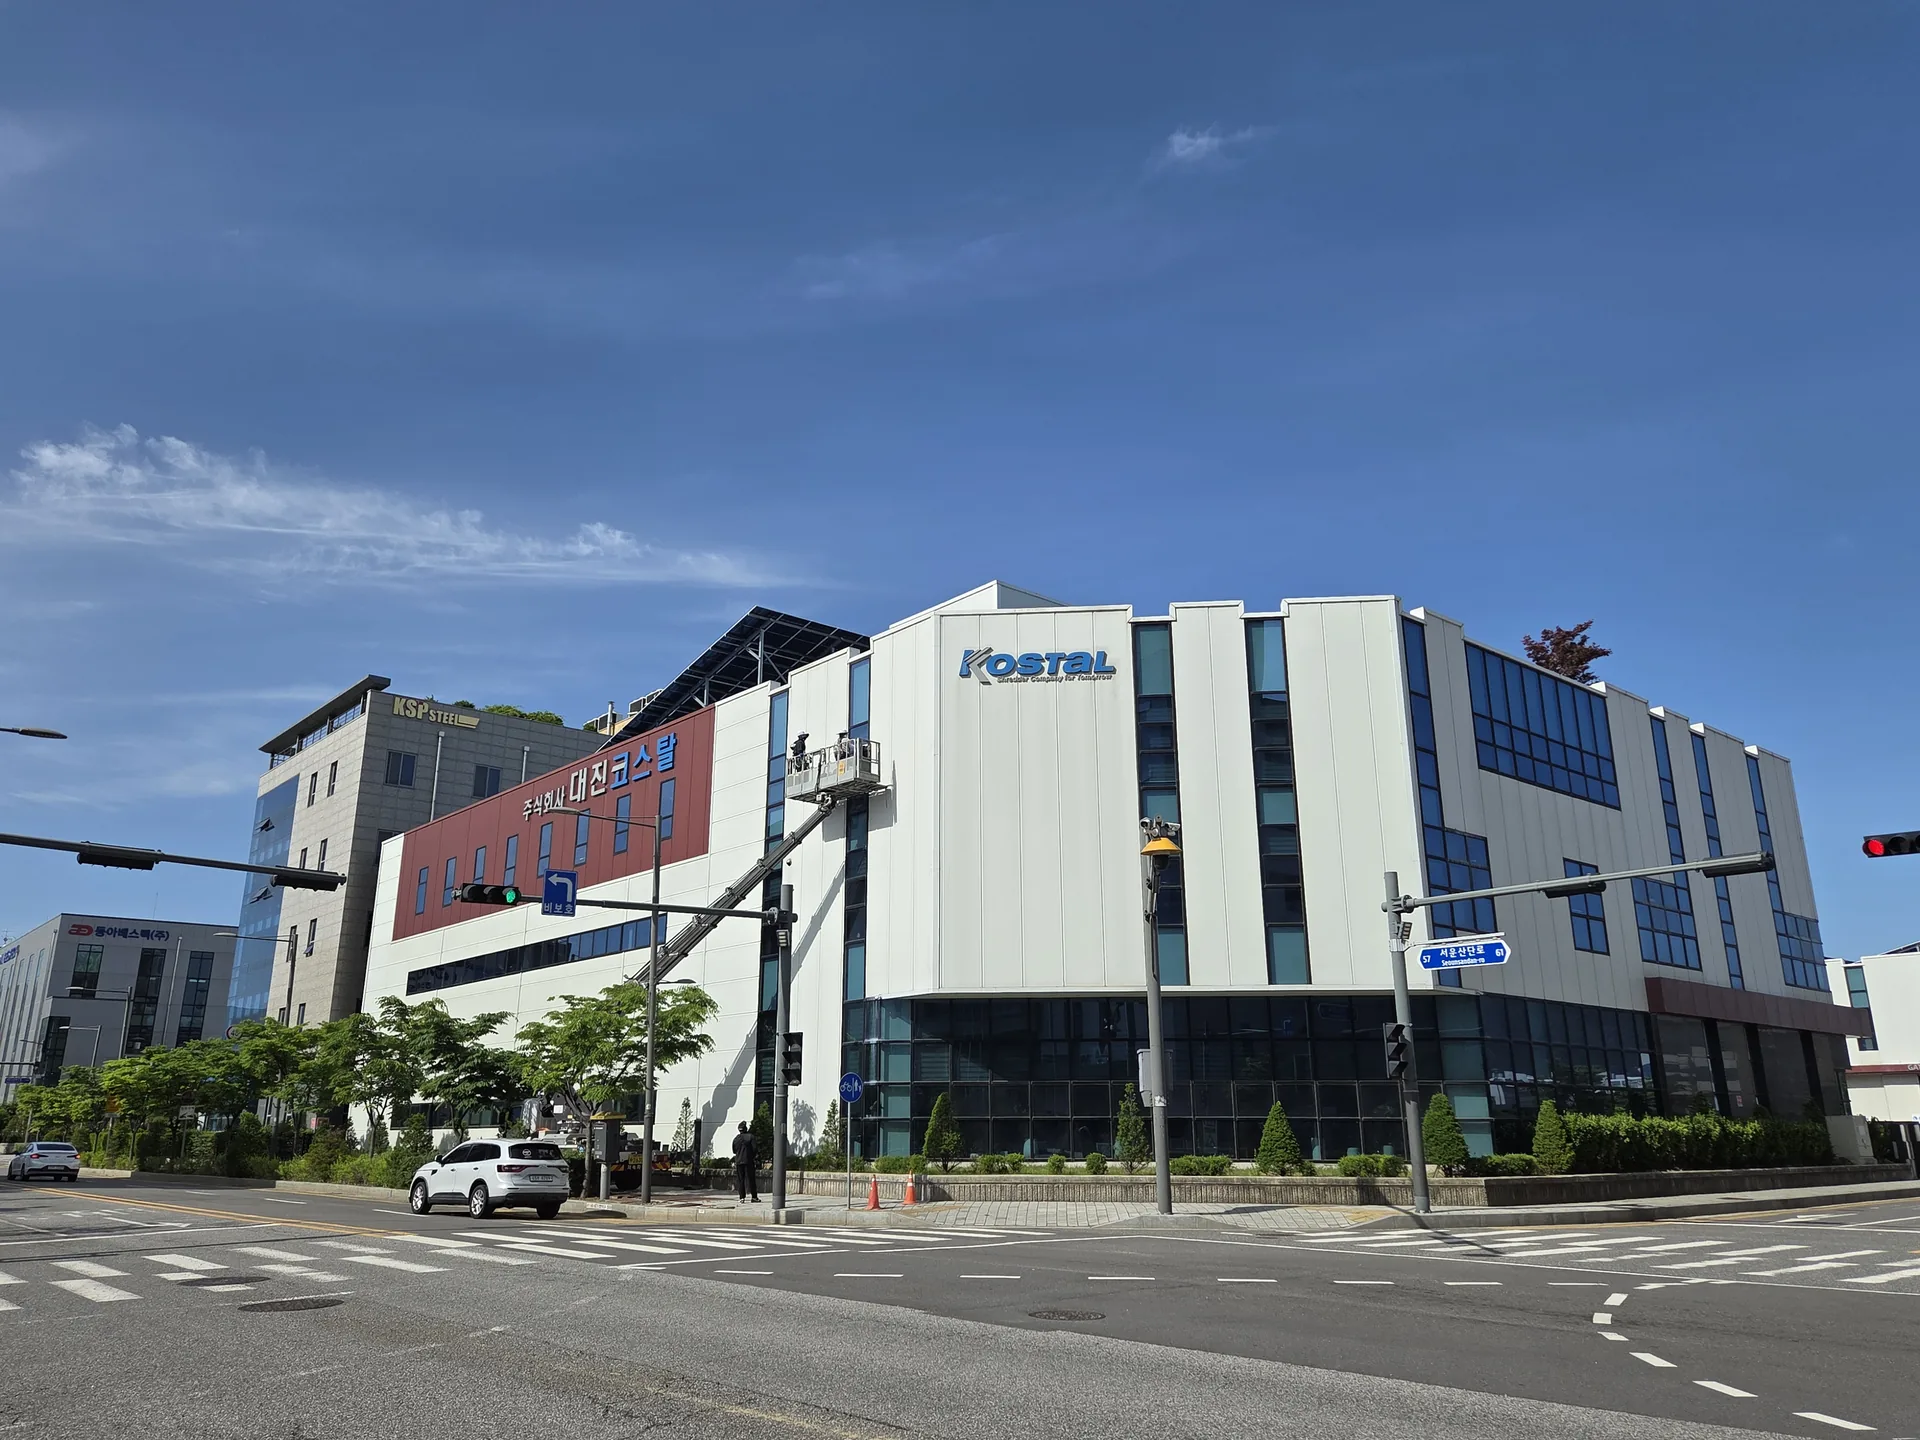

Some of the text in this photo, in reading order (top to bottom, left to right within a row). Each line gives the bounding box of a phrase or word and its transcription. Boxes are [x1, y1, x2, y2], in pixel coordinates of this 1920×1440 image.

[1030, 674, 1064, 684] Company
[1065, 674, 1076, 682] for
[1077, 674, 1113, 682] Tomorrow
[393, 696, 478, 729] KSP STEEL
[522, 785, 567, 822] 주식회사
[544, 902, 574, 914] 비보호
[1440, 946, 1485, 957] 서운산단로
[1422, 955, 1431, 963] 57
